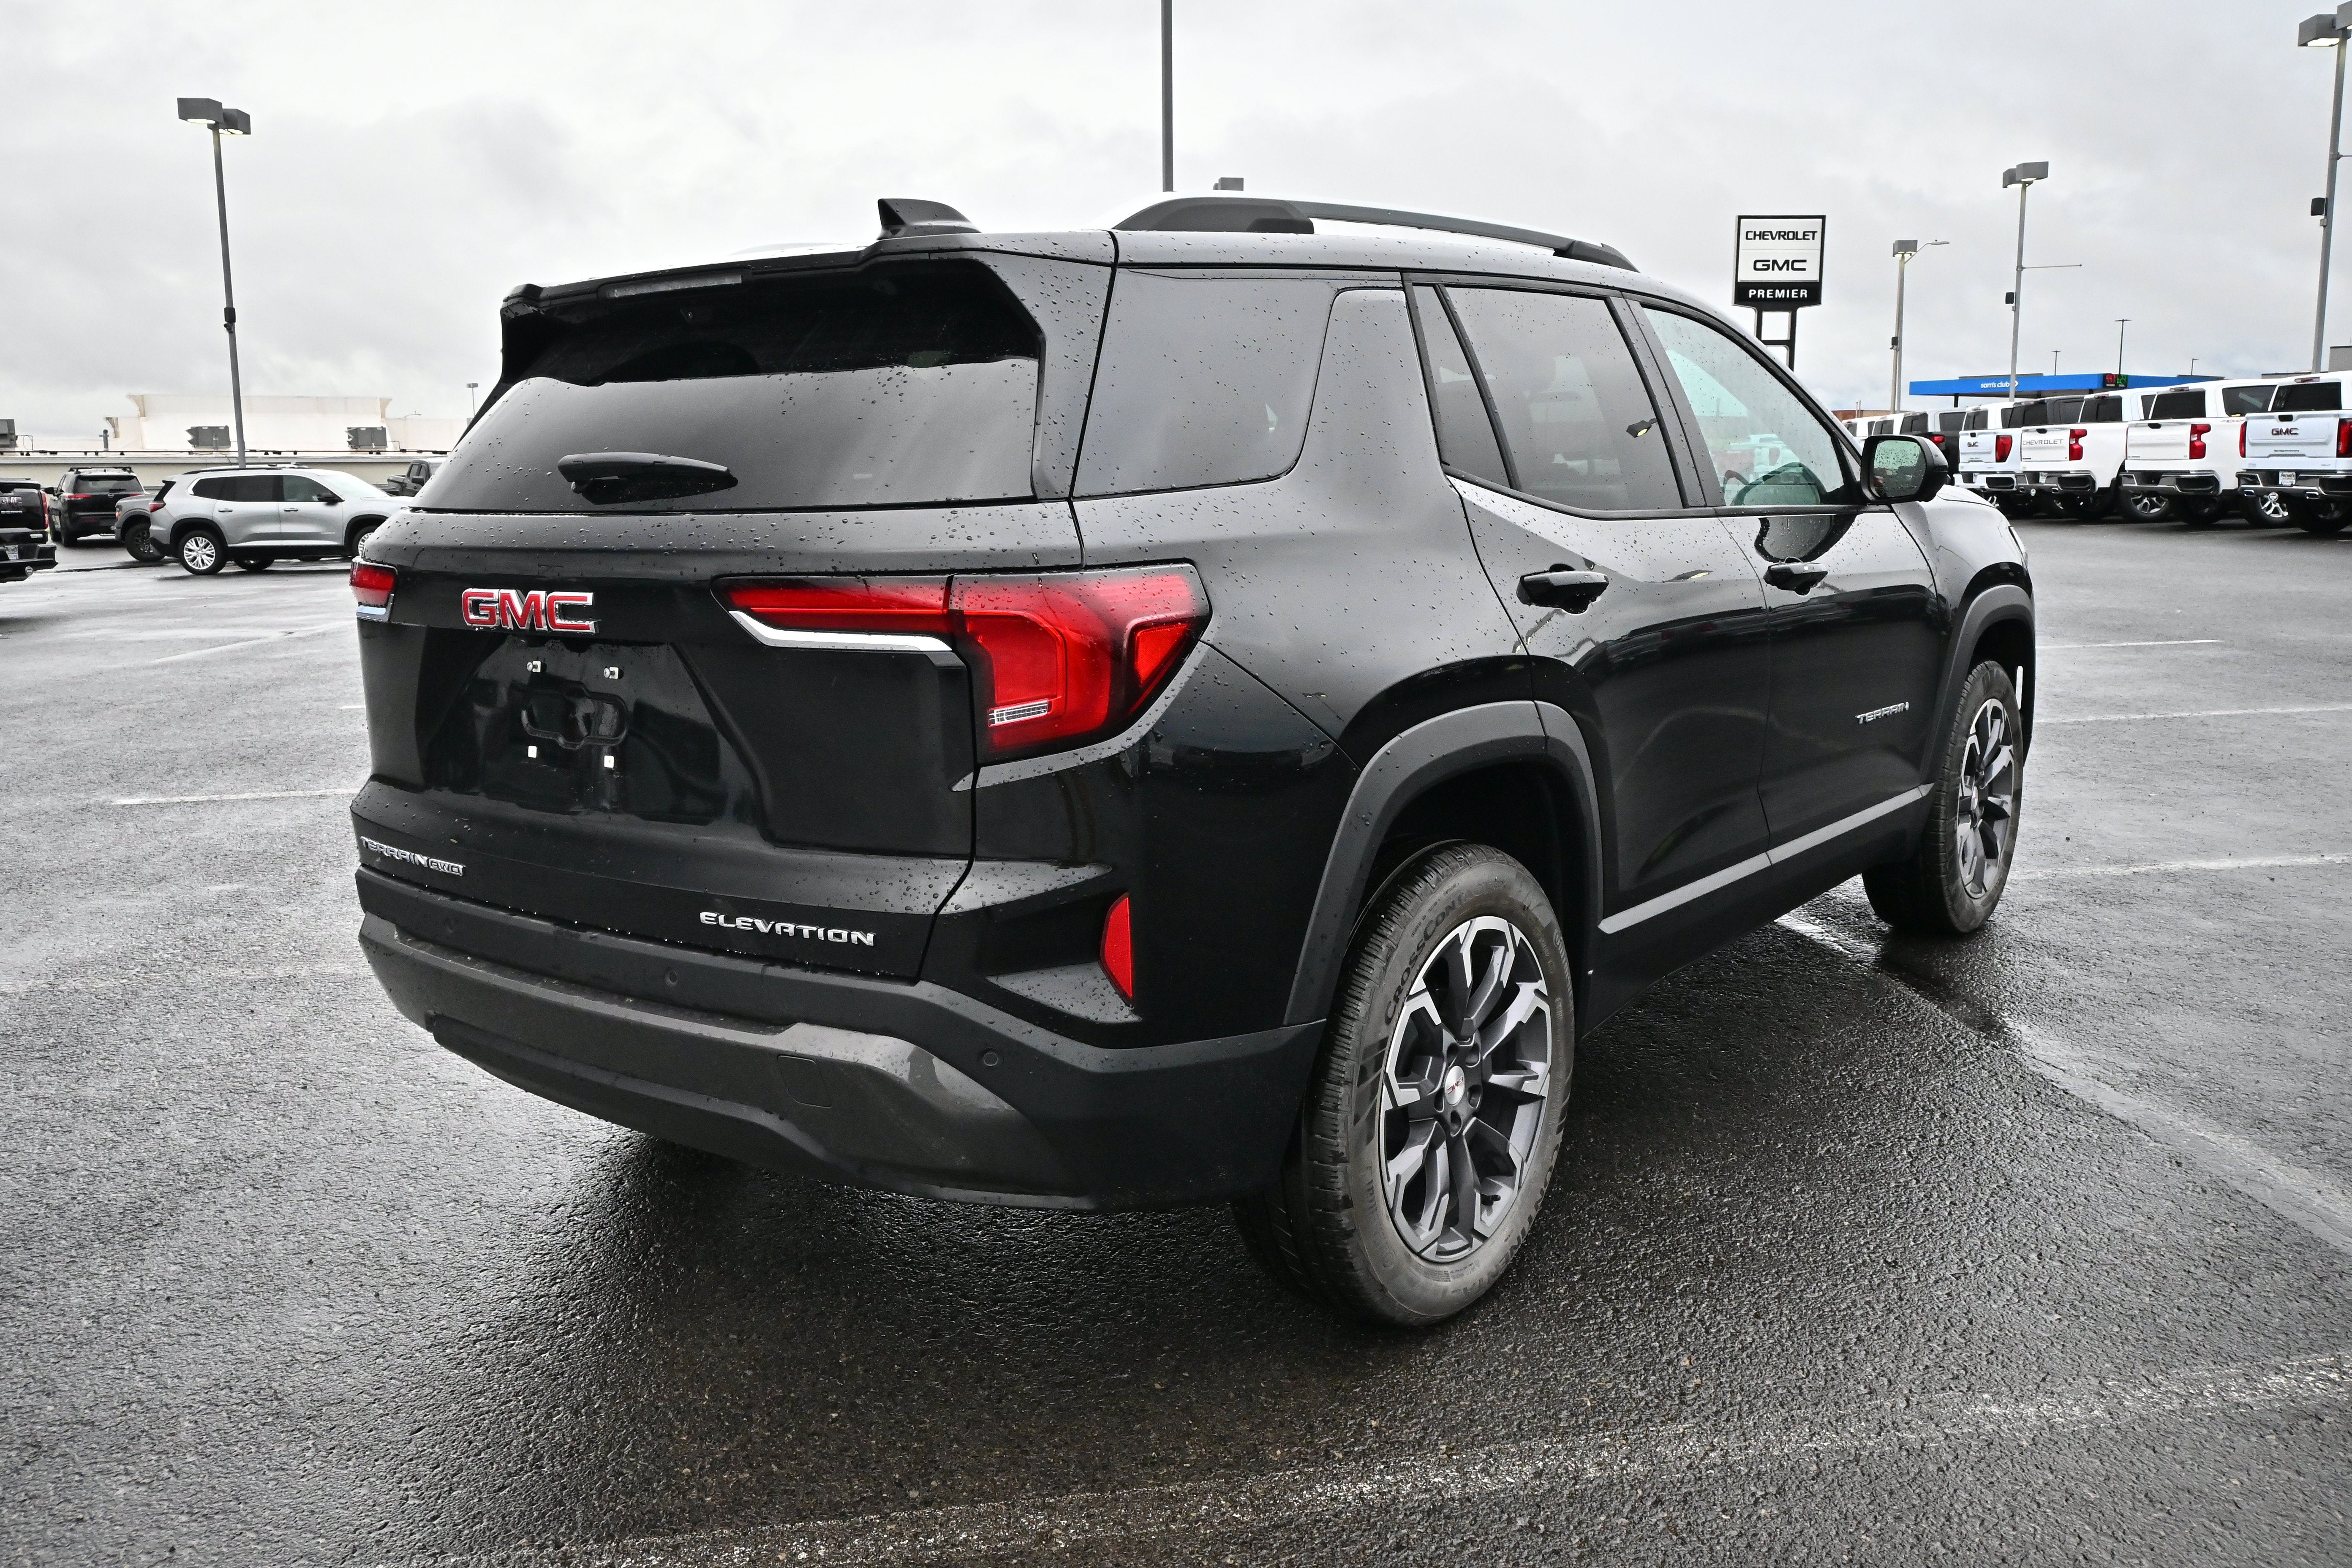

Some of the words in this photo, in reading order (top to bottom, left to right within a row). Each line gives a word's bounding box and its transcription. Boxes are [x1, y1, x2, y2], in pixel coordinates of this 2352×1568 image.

[1745, 231, 1818, 240] CHEVROLET
[1753, 259, 1807, 271] GMC
[1748, 289, 1808, 298] PREMIER
[2271, 427, 2299, 436] GMC
[462, 588, 596, 634] GMC
[1855, 701, 1910, 724] TERRAIN
[359, 836, 429, 868] TERRAIN
[429, 858, 466, 876] AWD
[700, 911, 877, 946] ELEVATION
[1447, 1076, 1464, 1094] GMC
